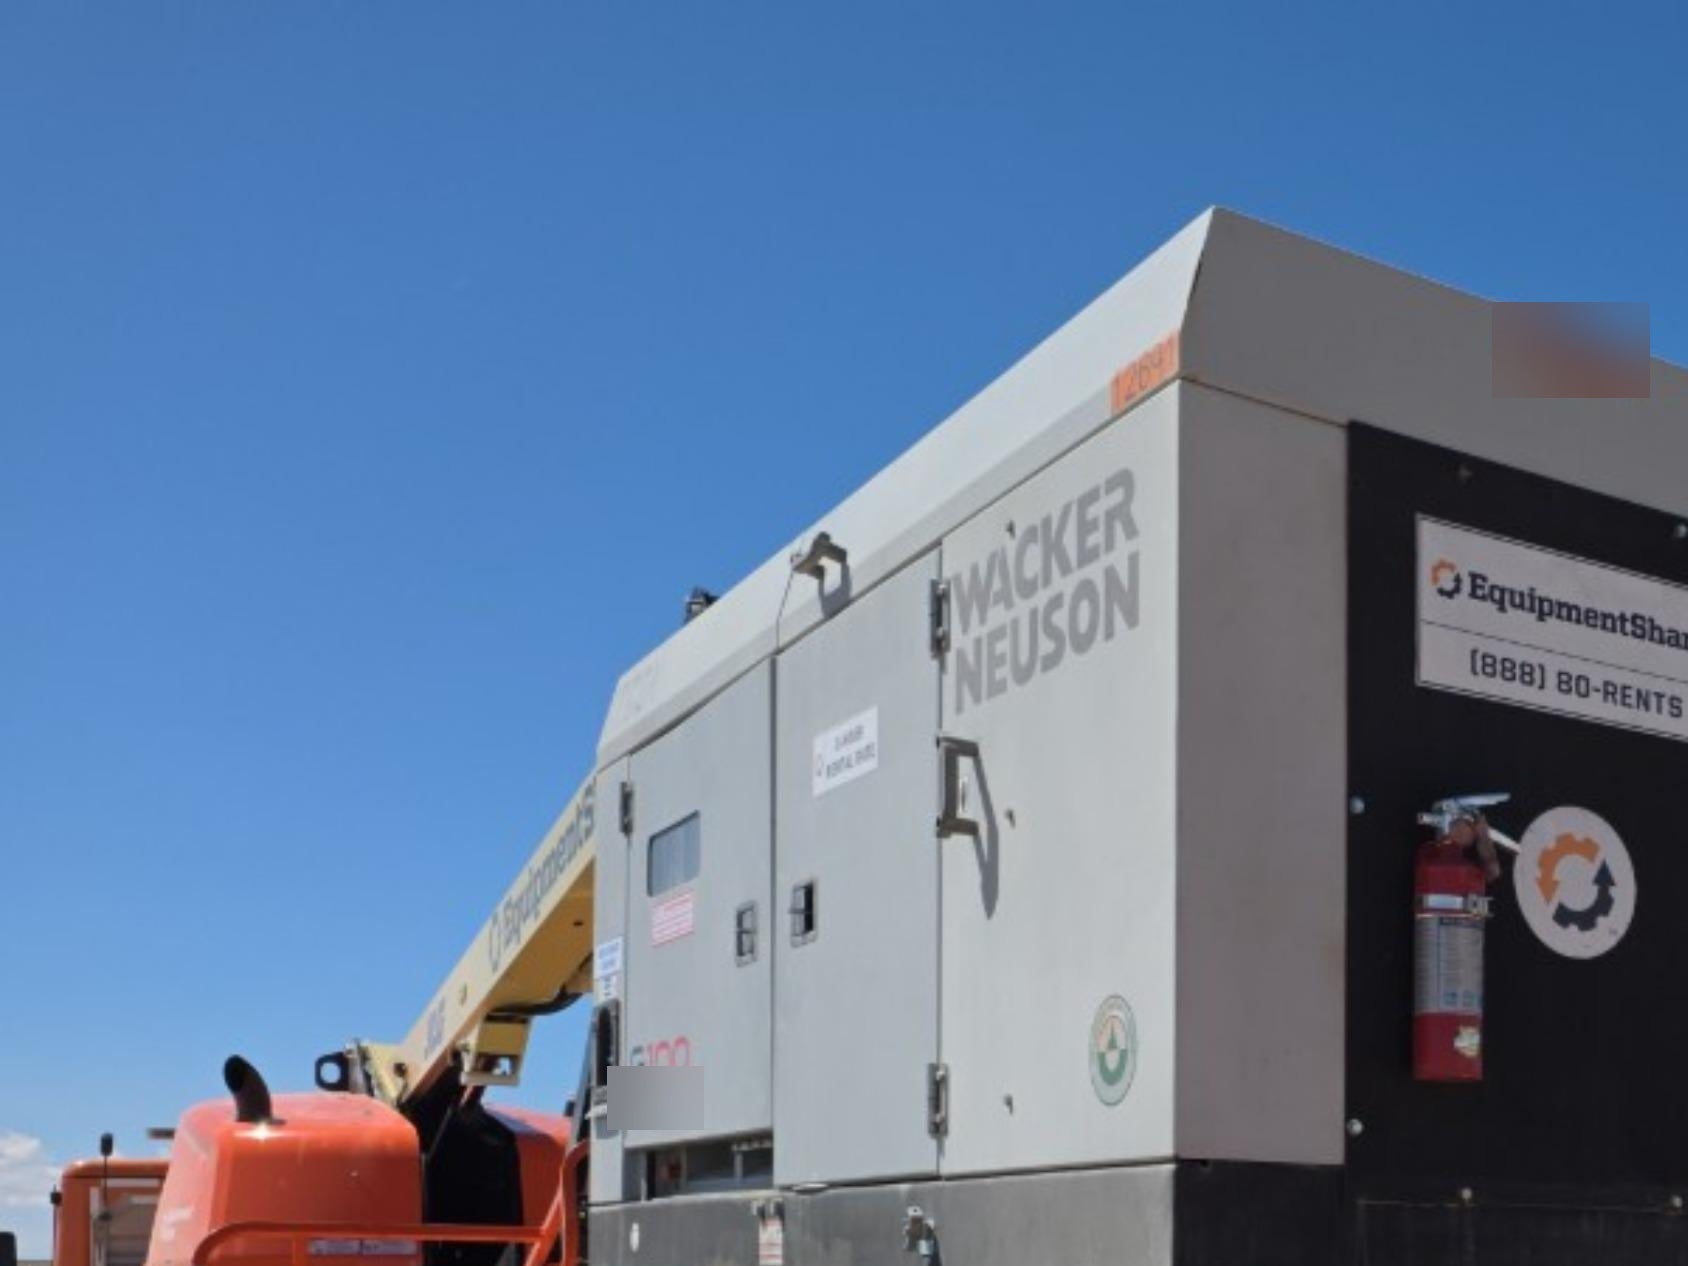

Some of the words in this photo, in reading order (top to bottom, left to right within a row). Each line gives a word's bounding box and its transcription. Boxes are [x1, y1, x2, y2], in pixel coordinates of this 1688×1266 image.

[952, 467, 1140, 636] WACKER
[955, 550, 1140, 716] NEUSON
[1470, 648, 1546, 691] (888)
[503, 776, 597, 950] EquipmentS
